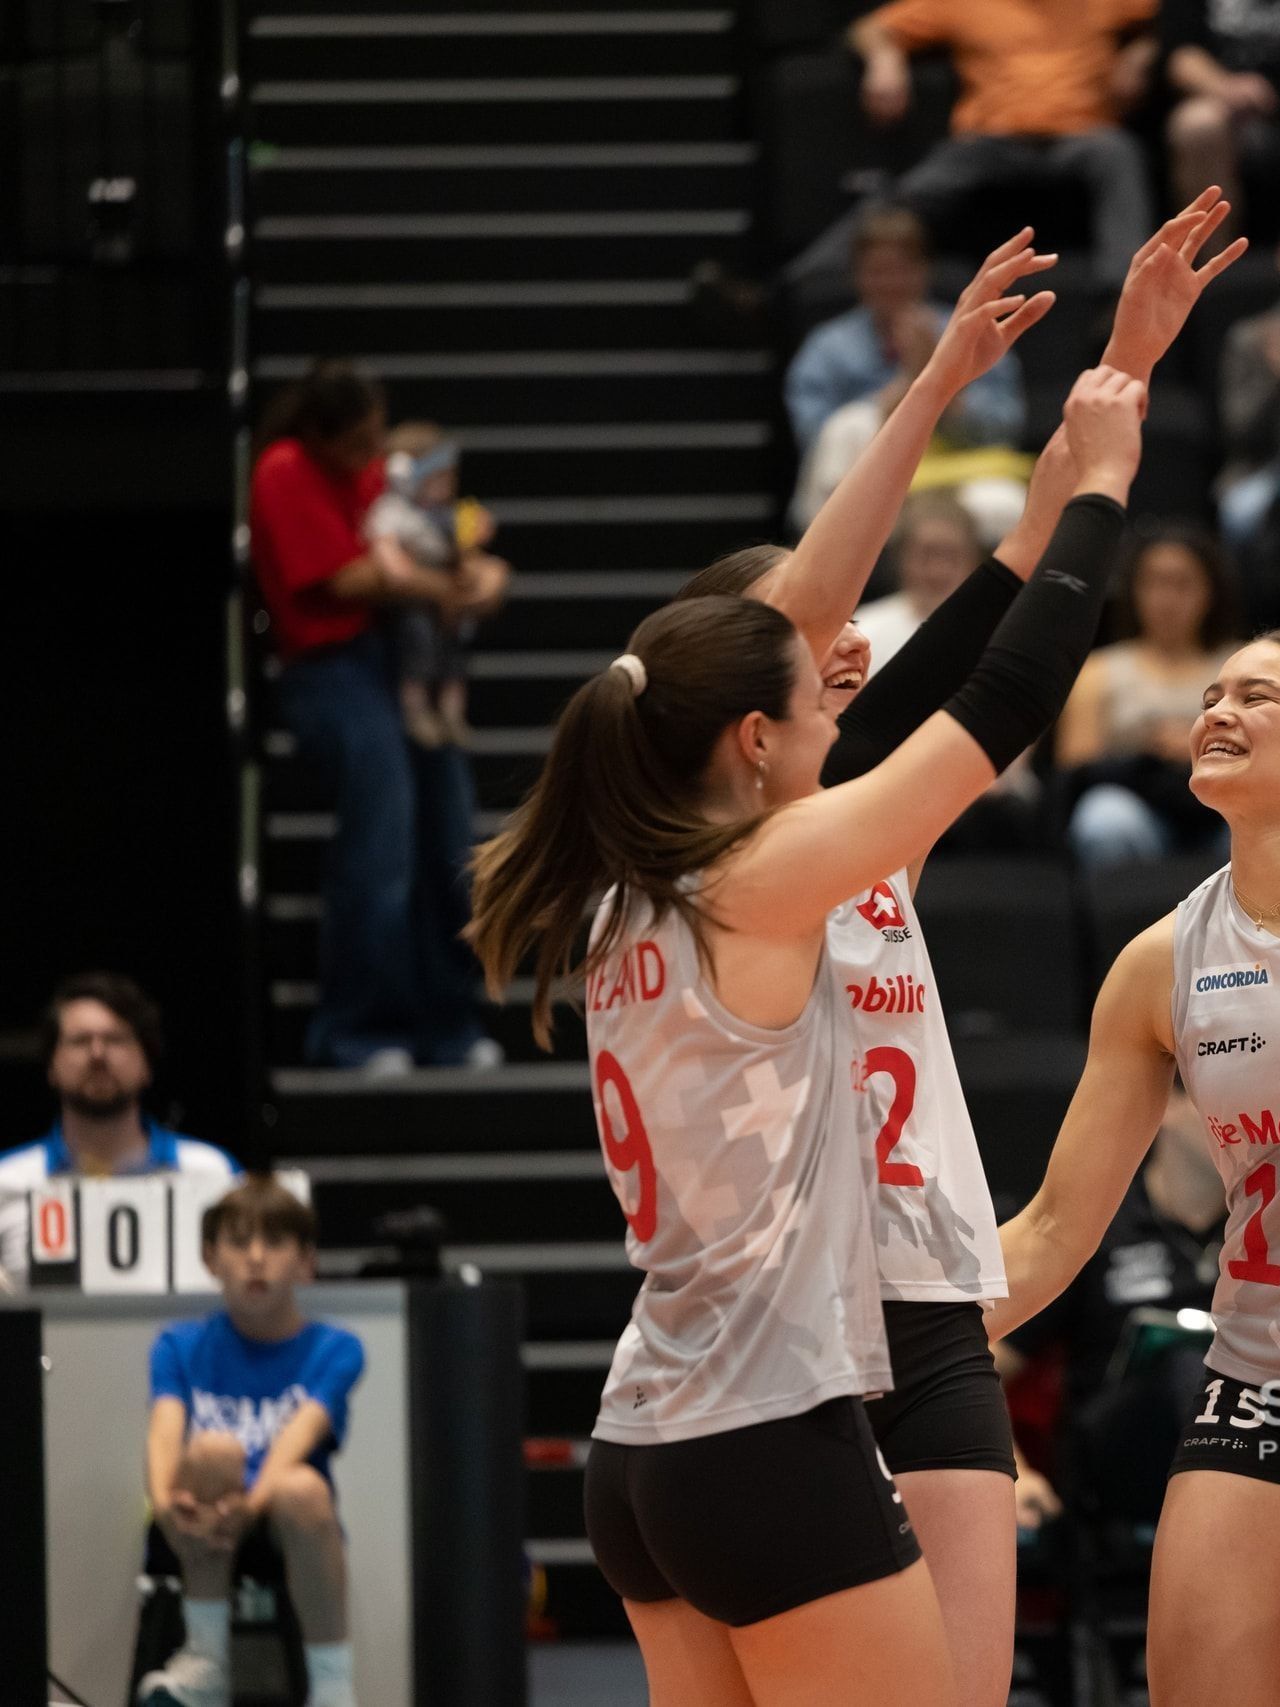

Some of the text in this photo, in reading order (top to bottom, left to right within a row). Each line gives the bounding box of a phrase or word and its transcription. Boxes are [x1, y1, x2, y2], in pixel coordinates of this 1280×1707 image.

[1197, 1036, 1250, 1057] CRAFT
[596, 1049, 657, 1243] 9
[853, 1046, 925, 1187] 2
[108, 1205, 140, 1272] 0
[1184, 1437, 1231, 1448] CRAFT
